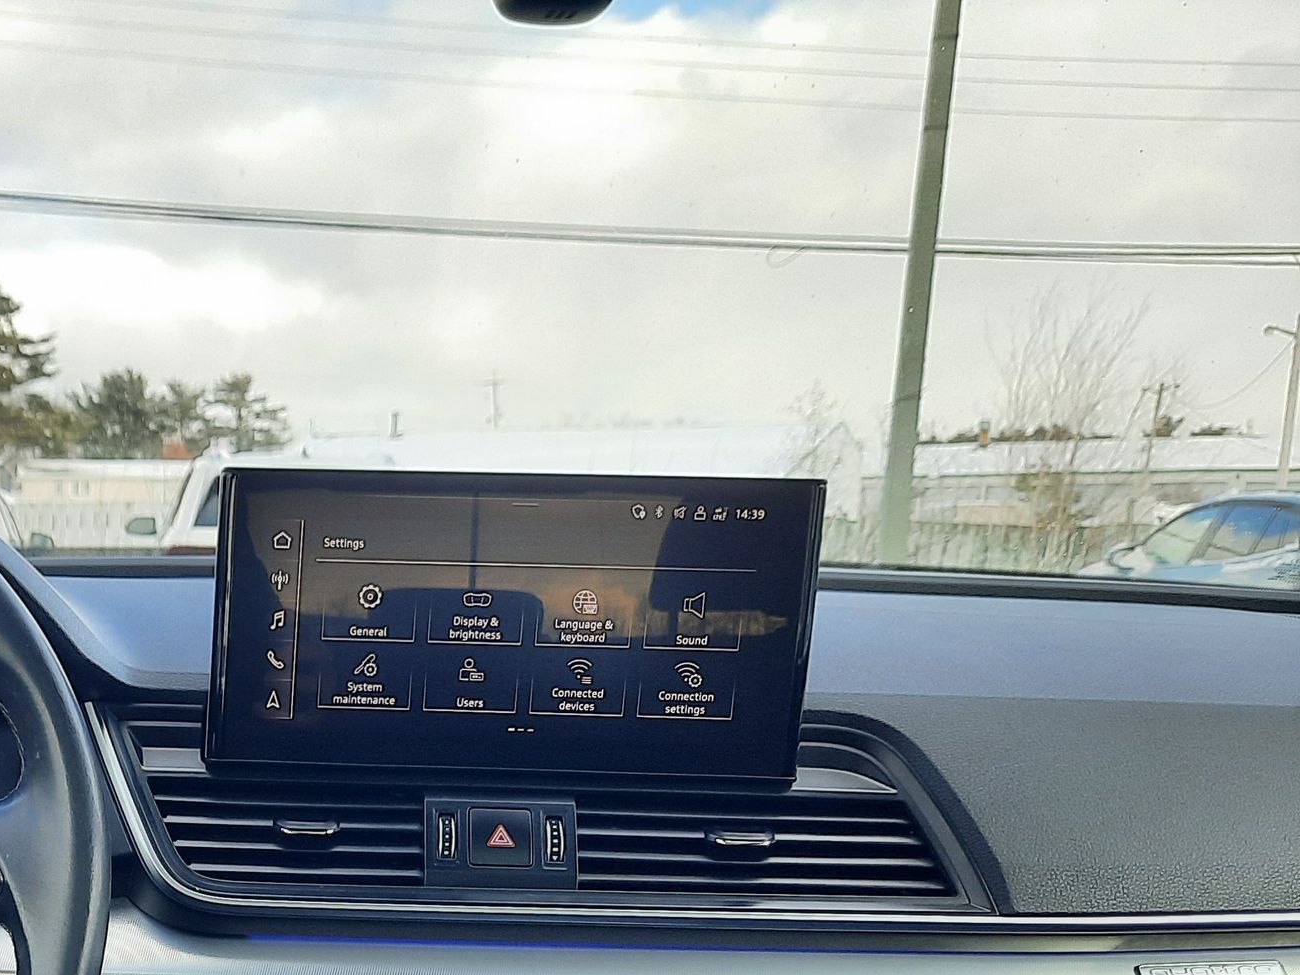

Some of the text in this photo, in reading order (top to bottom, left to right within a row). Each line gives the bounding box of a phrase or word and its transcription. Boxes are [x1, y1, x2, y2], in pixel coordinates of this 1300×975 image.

[735, 508, 765, 520] 14:39
[323, 537, 365, 551] Settings
[453, 616, 499, 628] Display &
[554, 619, 614, 631] Language &
[349, 626, 387, 637] General
[449, 628, 501, 641] brightness
[560, 631, 606, 644] keyboard
[675, 635, 709, 646] Sound
[347, 682, 382, 693] System
[551, 688, 604, 699] Connected
[658, 691, 715, 702] Connection
[332, 695, 396, 706] maintenance
[456, 697, 484, 708] Users
[558, 701, 595, 712] devices
[664, 704, 706, 717] settings
